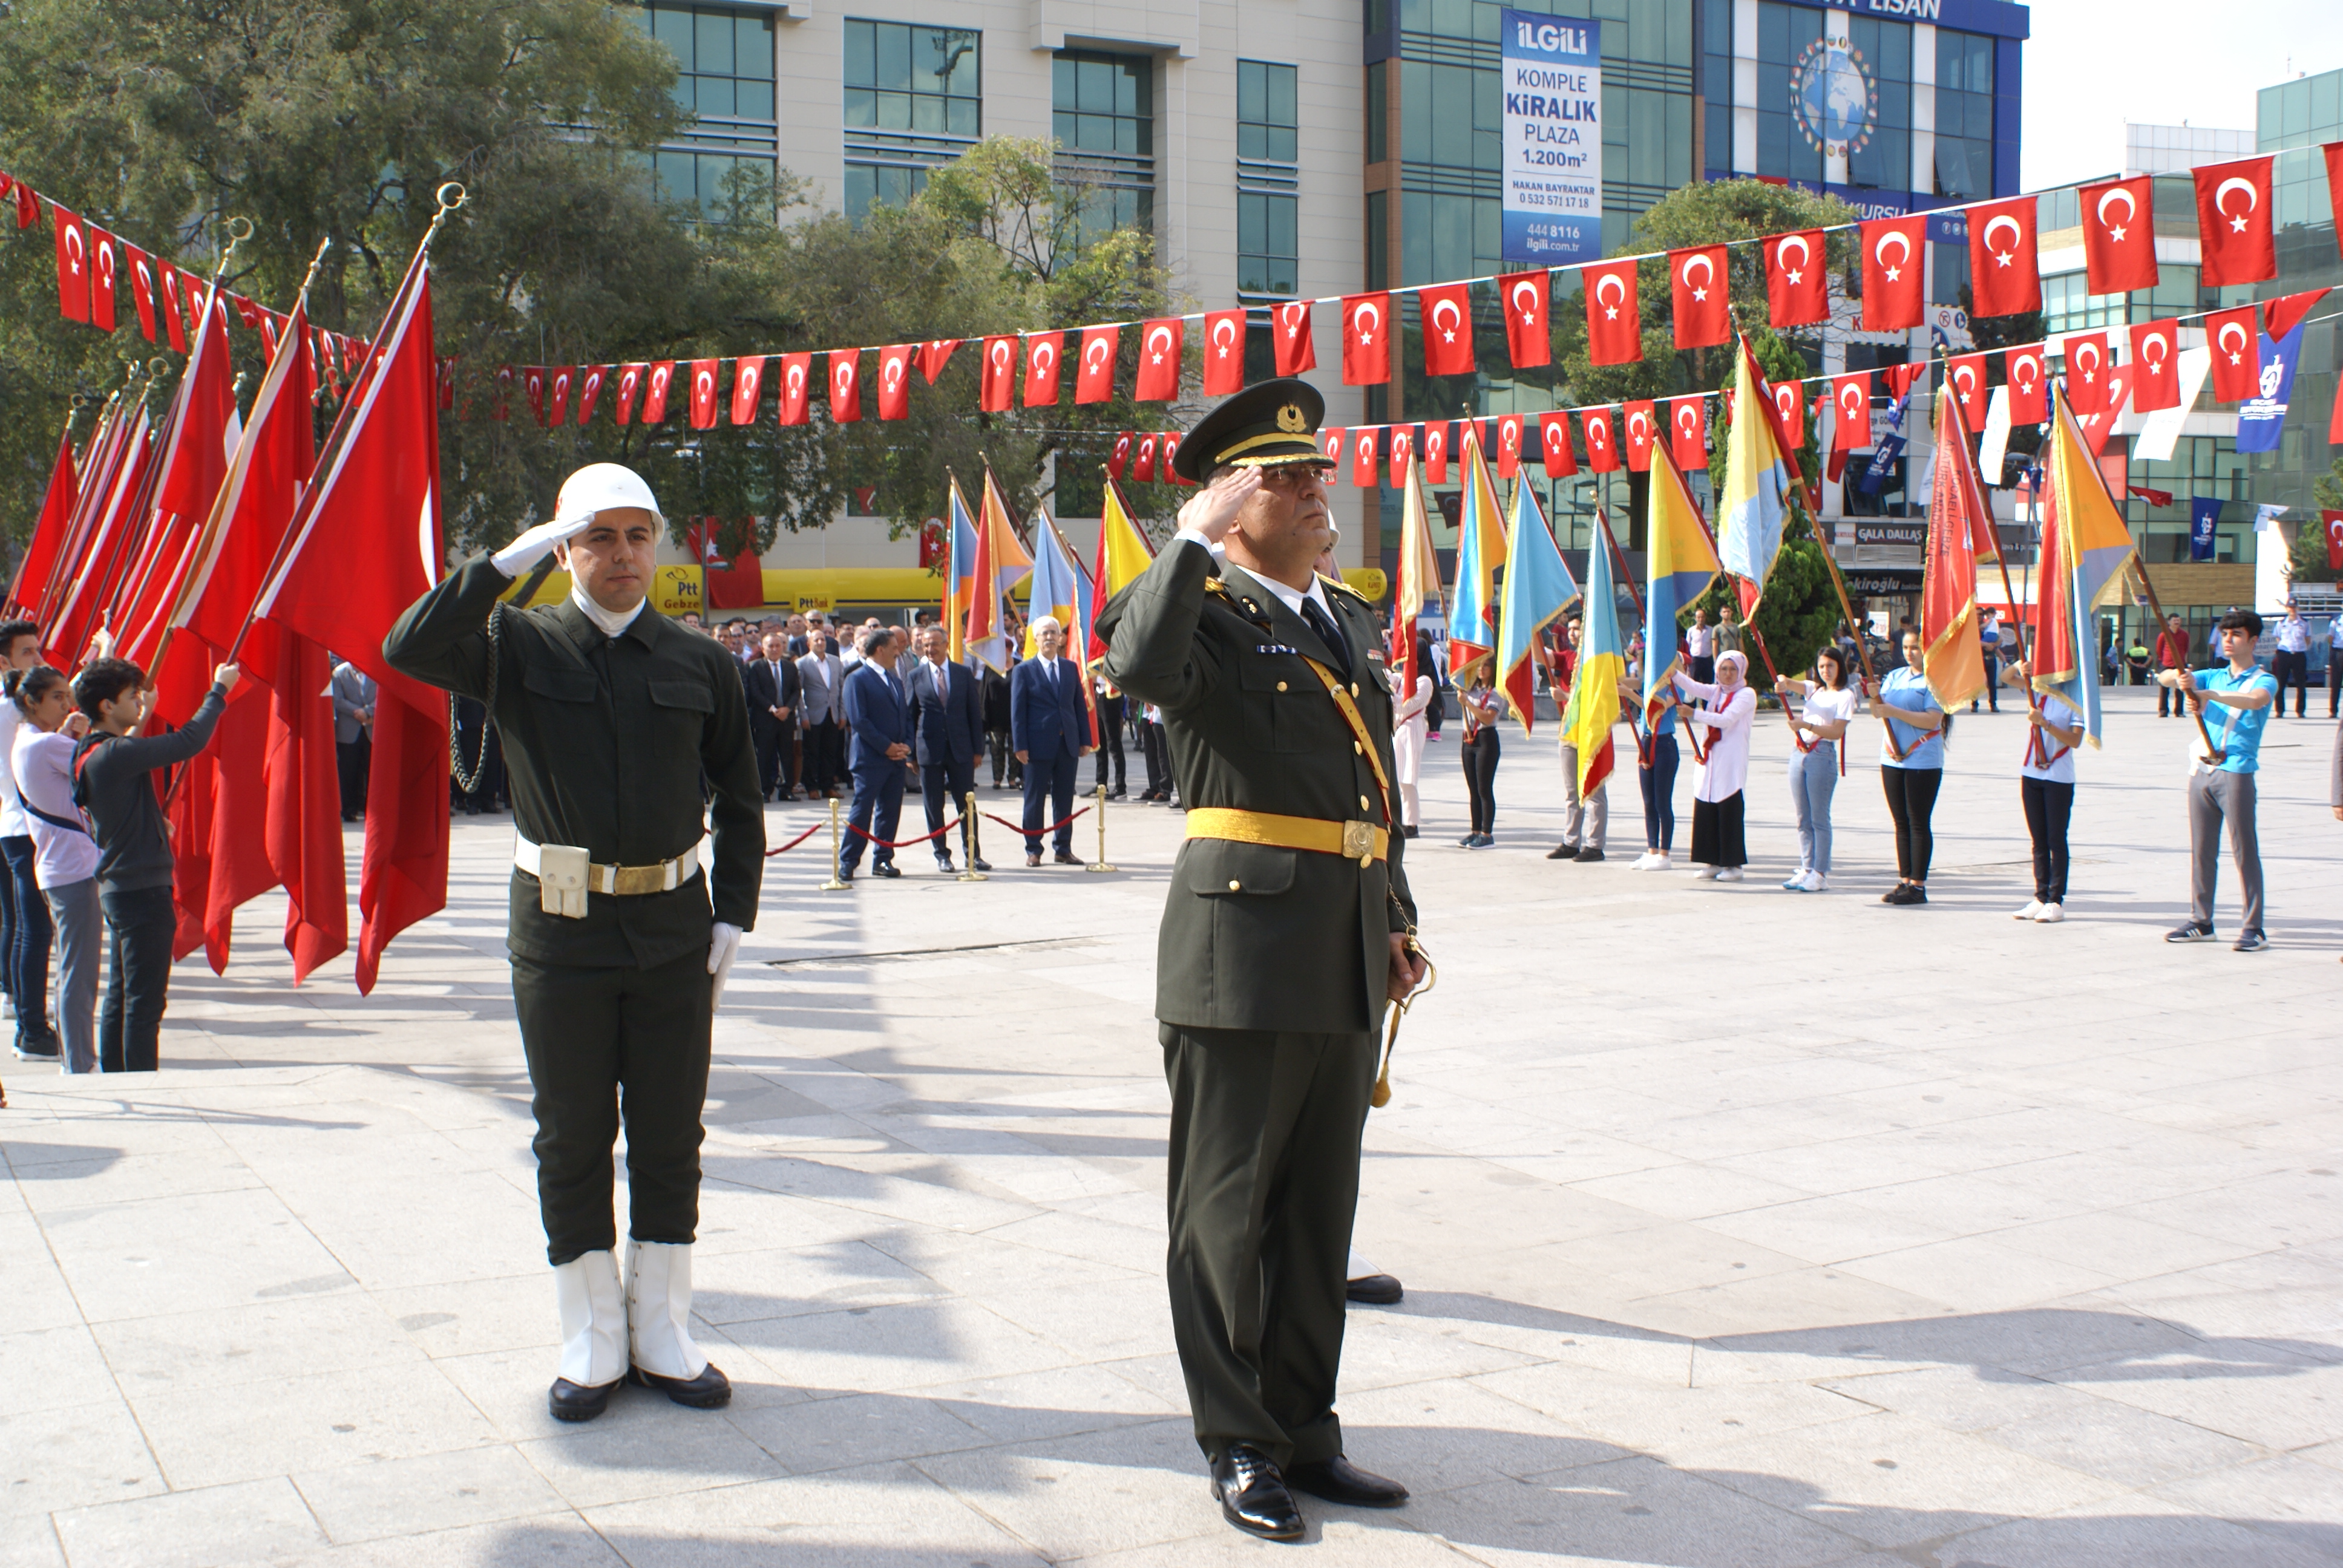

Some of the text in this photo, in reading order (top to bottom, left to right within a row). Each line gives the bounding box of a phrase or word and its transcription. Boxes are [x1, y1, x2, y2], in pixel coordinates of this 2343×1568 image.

[1517, 68, 1587, 93] KOMPLE
[1525, 123, 1580, 145] PLAZA
[1512, 180, 1595, 195] HAKAN BAYRAKTAR
[1519, 192, 1589, 208] 0 532 571 17 18
[1527, 223, 1580, 238] 444 8116
[1527, 238, 1579, 252] ilgili.com.tr
[1858, 528, 1886, 542] GALA
[678, 581, 698, 596] Ptt
[664, 598, 700, 609] Gebze
